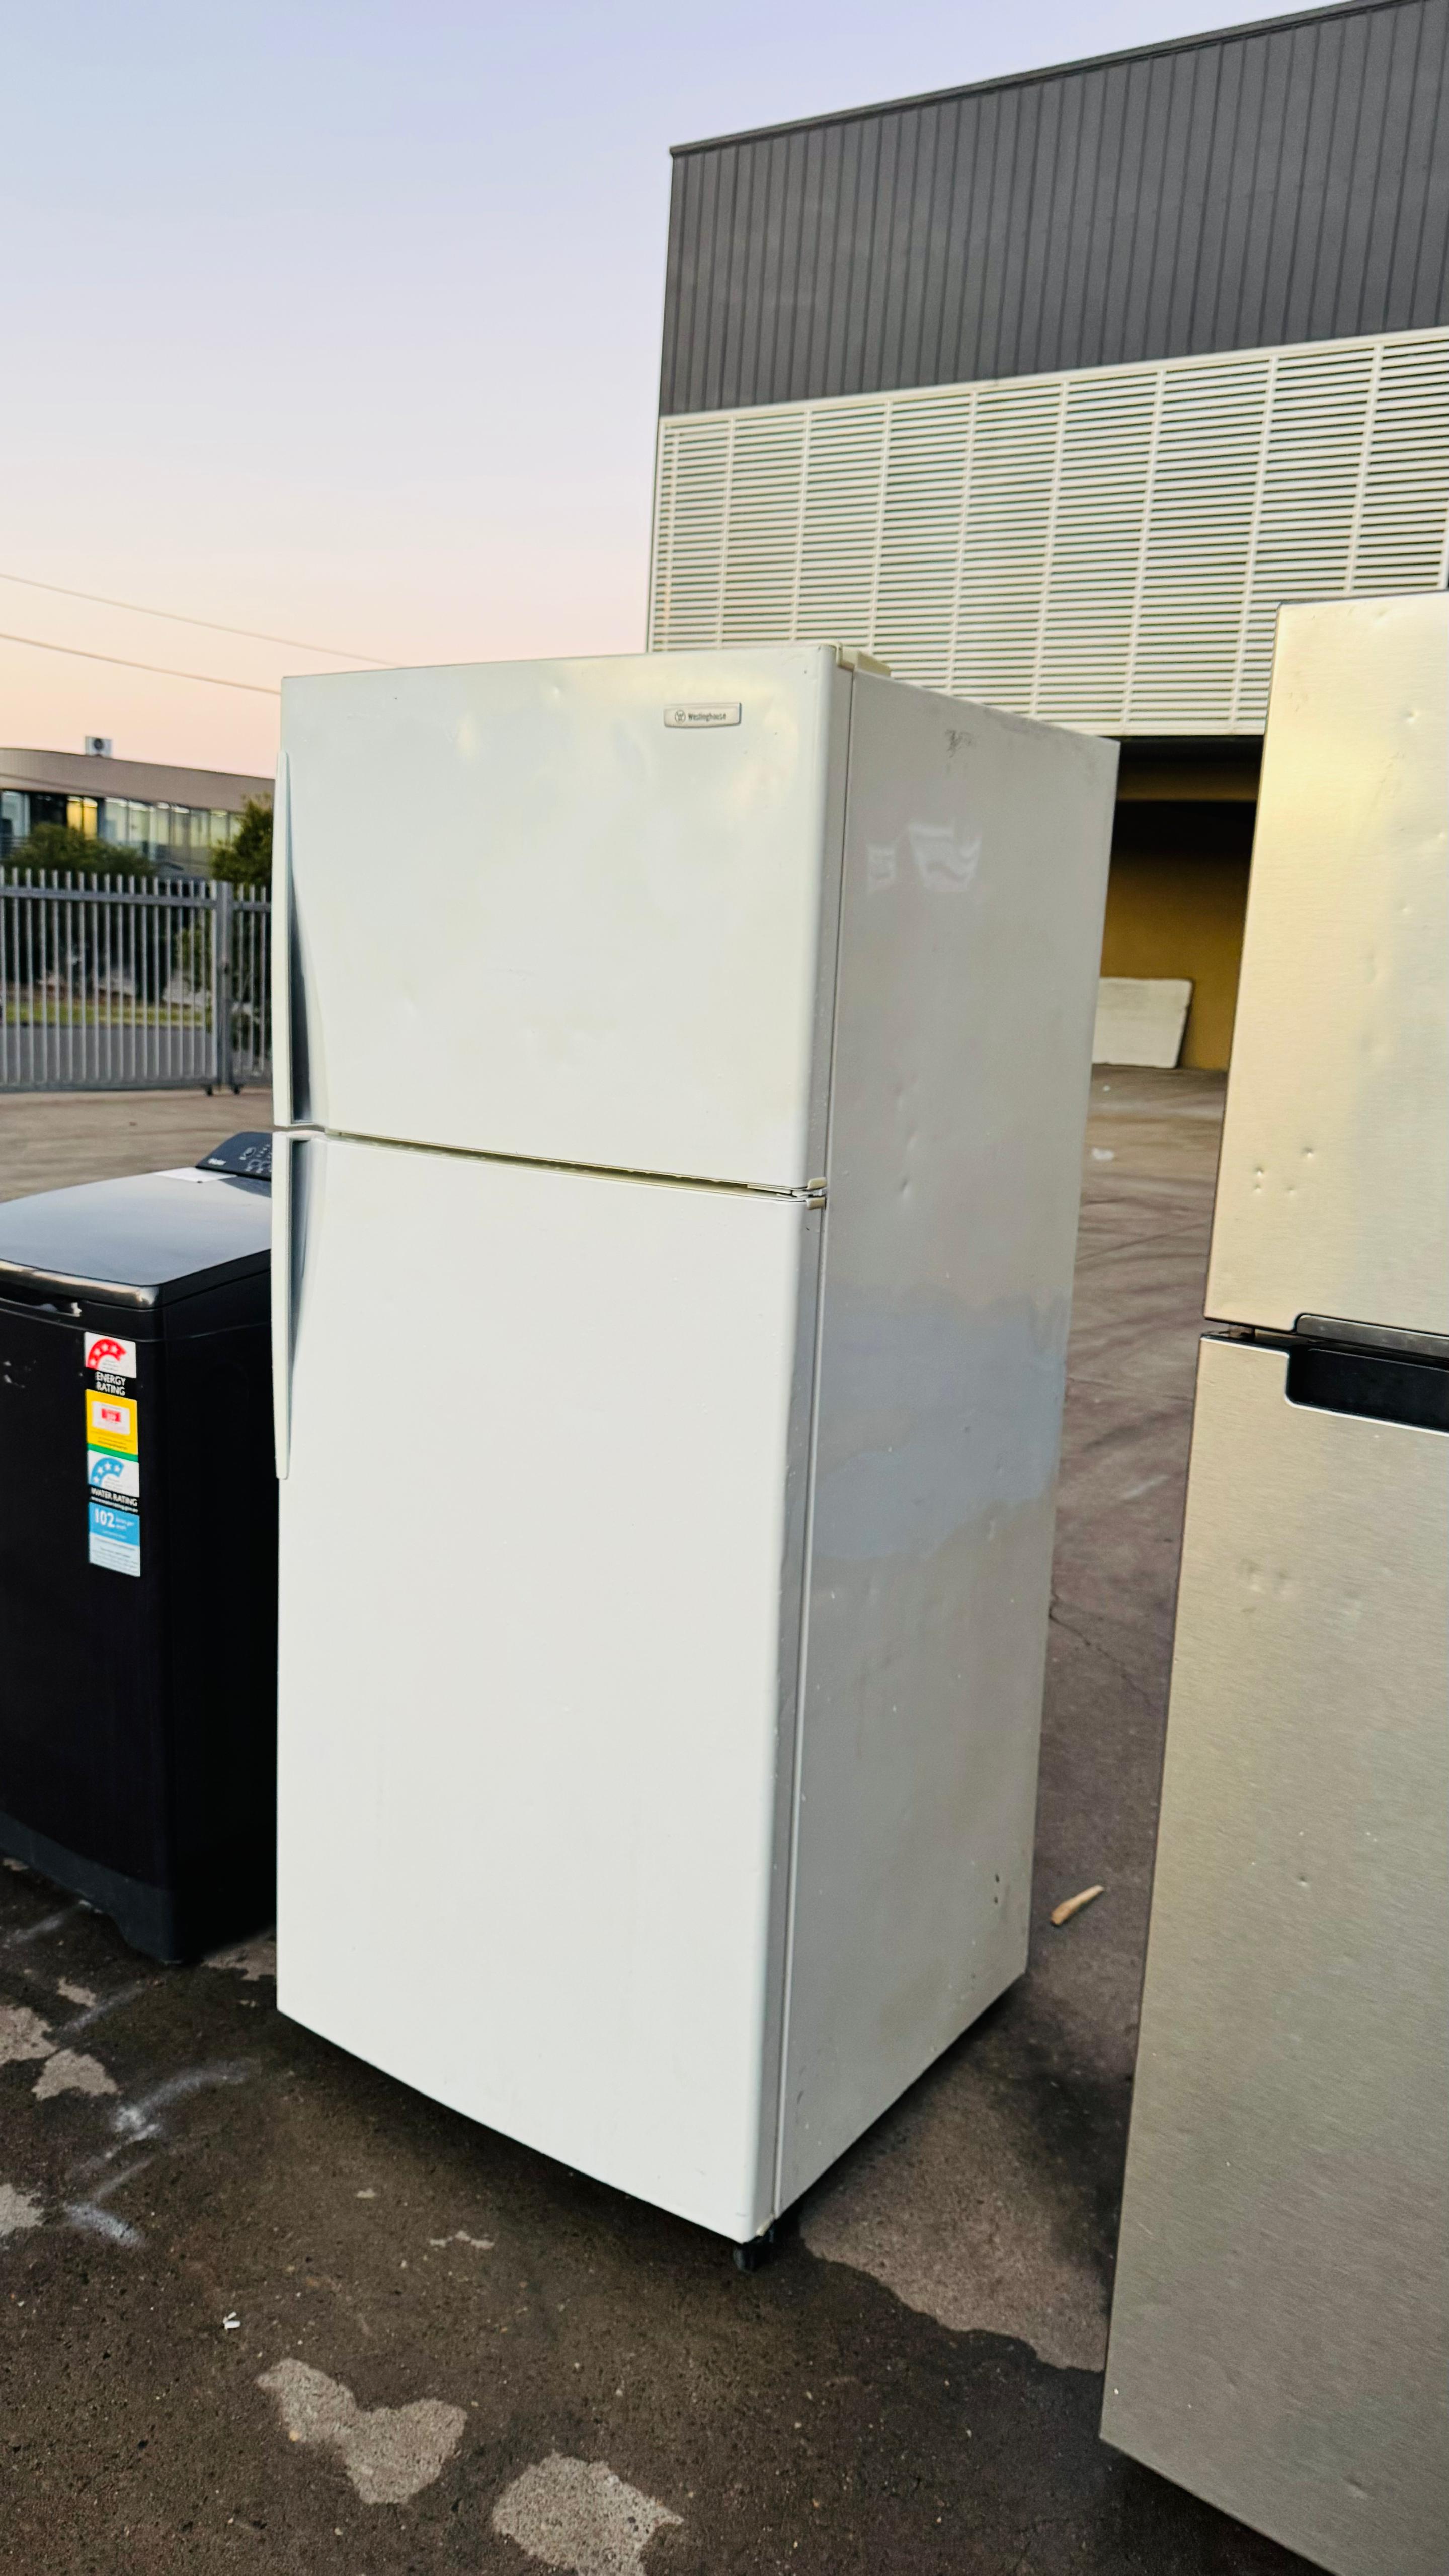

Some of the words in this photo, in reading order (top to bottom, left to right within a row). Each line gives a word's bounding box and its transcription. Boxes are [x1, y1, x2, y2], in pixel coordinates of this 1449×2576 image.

[688, 713, 726, 722] Westinghouse
[95, 1371, 126, 1386] ENERGY
[96, 1381, 125, 1396] RATING
[91, 1487, 113, 1500] WATER
[113, 1493, 138, 1507] RATING
[95, 1508, 115, 1528] 102
